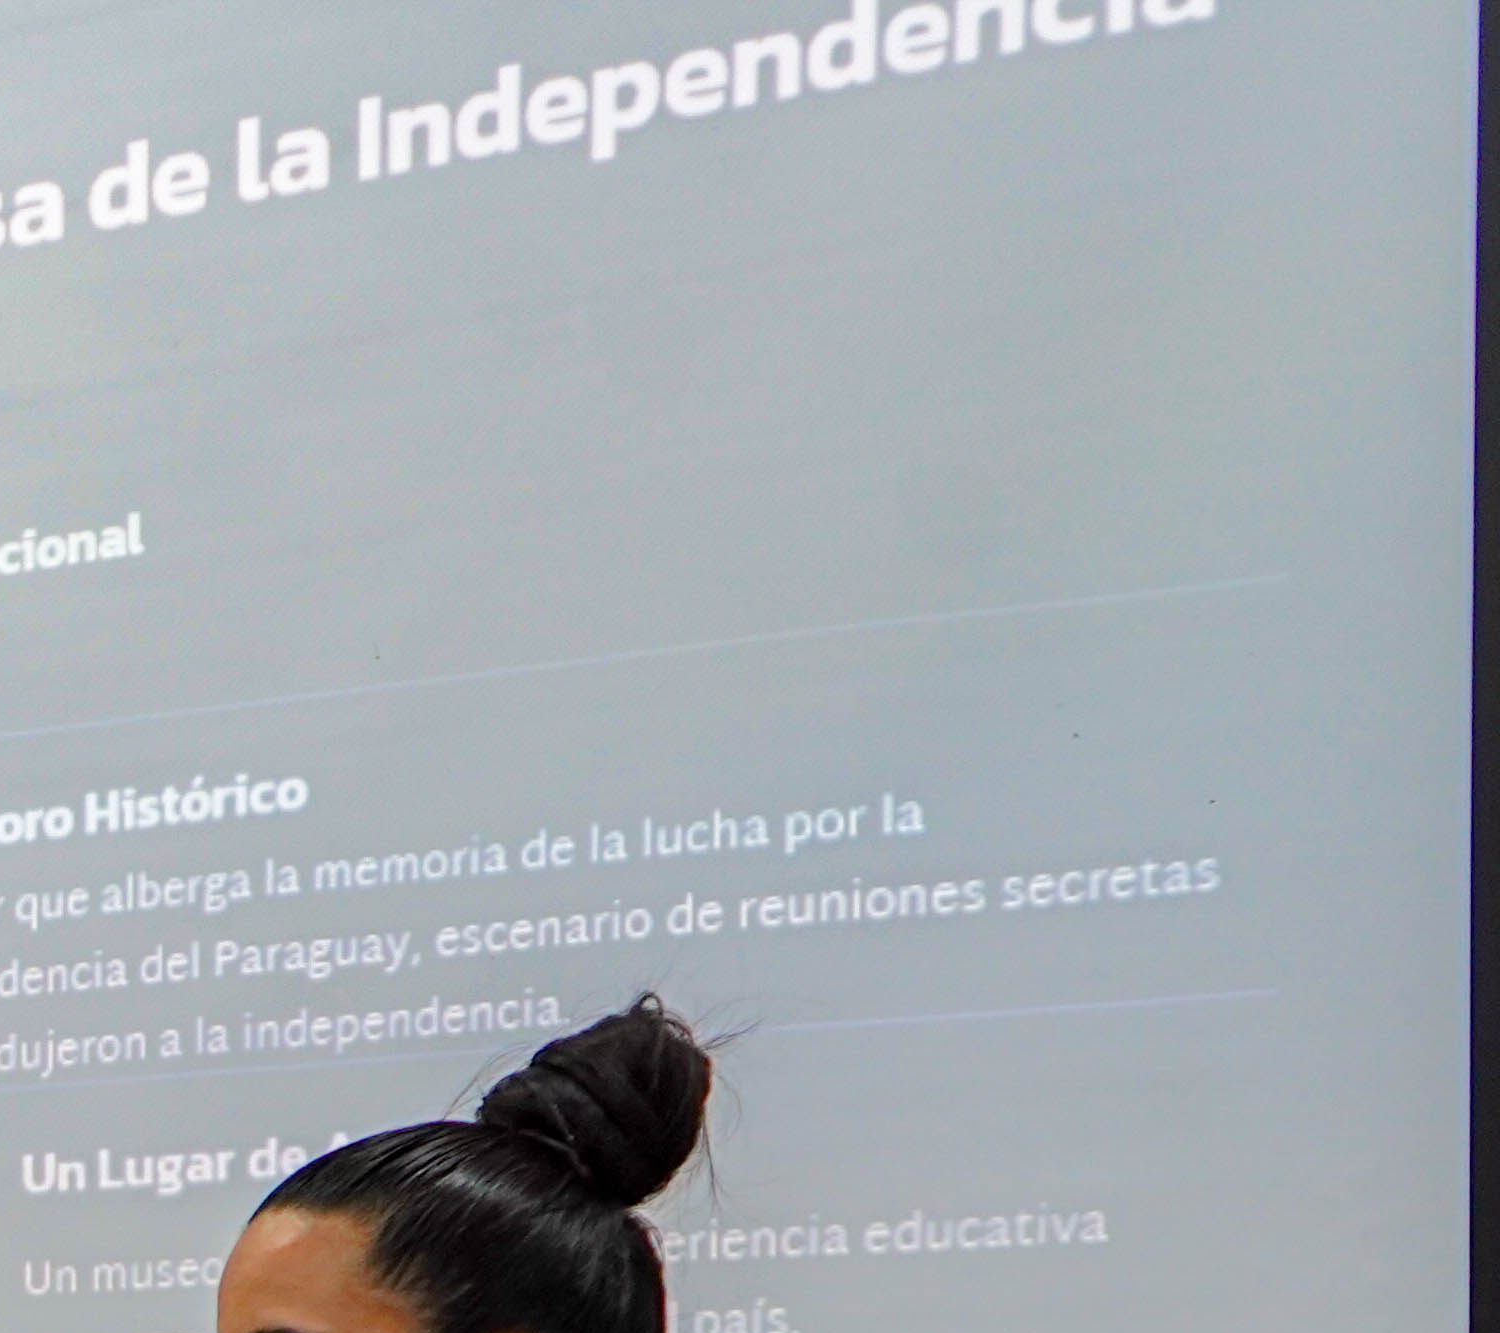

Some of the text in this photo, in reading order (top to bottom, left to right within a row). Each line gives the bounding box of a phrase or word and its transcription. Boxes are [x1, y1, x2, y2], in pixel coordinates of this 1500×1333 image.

[88, 138, 210, 230] de
[237, 115, 330, 202] la
[84, 772, 308, 835] Histórico
[14, 887, 90, 931] que
[100, 869, 252, 914] alberga
[264, 857, 300, 895] la
[314, 842, 508, 891] memoria
[520, 828, 576, 870] de
[590, 822, 628, 863] la
[642, 808, 770, 857] lucha
[784, 805, 866, 854] por
[882, 792, 925, 835] la
[140, 940, 200, 985] del
[214, 931, 421, 980] Paraguay,
[434, 898, 653, 957] escenario
[666, 891, 723, 936] de
[739, 876, 986, 929] reuniones
[1001, 857, 1220, 909] secretas
[159, 1028, 183, 1059] a
[195, 1015, 230, 1054] la
[243, 986, 570, 1053] independencia.
[22, 1151, 86, 1194] Un
[97, 1147, 235, 1196] Lugar
[248, 1137, 307, 1179] de
[24, 1260, 77, 1296] Un
[664, 1214, 850, 1263] eriencia
[863, 1202, 1109, 1254] educativa
